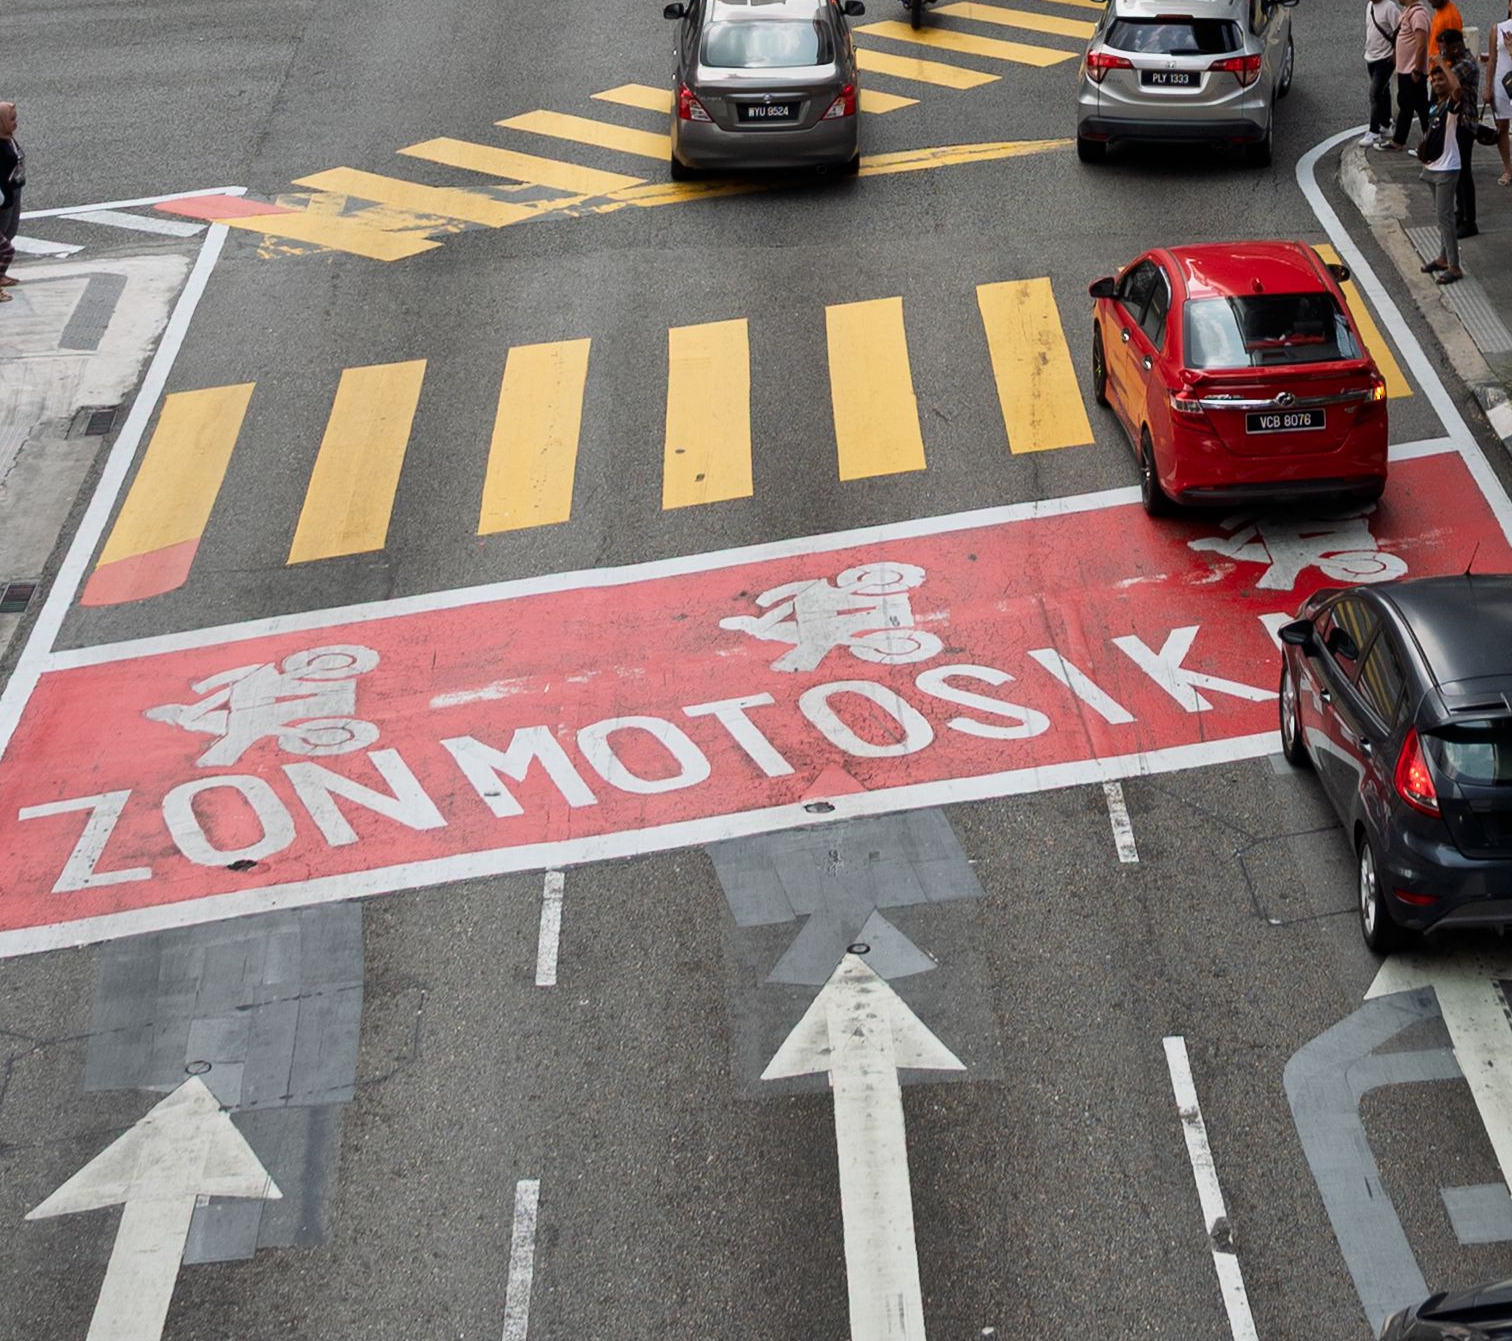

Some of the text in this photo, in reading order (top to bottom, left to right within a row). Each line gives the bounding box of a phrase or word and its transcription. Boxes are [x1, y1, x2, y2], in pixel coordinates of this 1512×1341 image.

[1152, 72, 1189, 84] PLY 1333
[748, 107, 766, 117] WYU
[1260, 413, 1312, 429] VCB 8076
[17, 614, 1288, 897] ZON MOTOSIK
